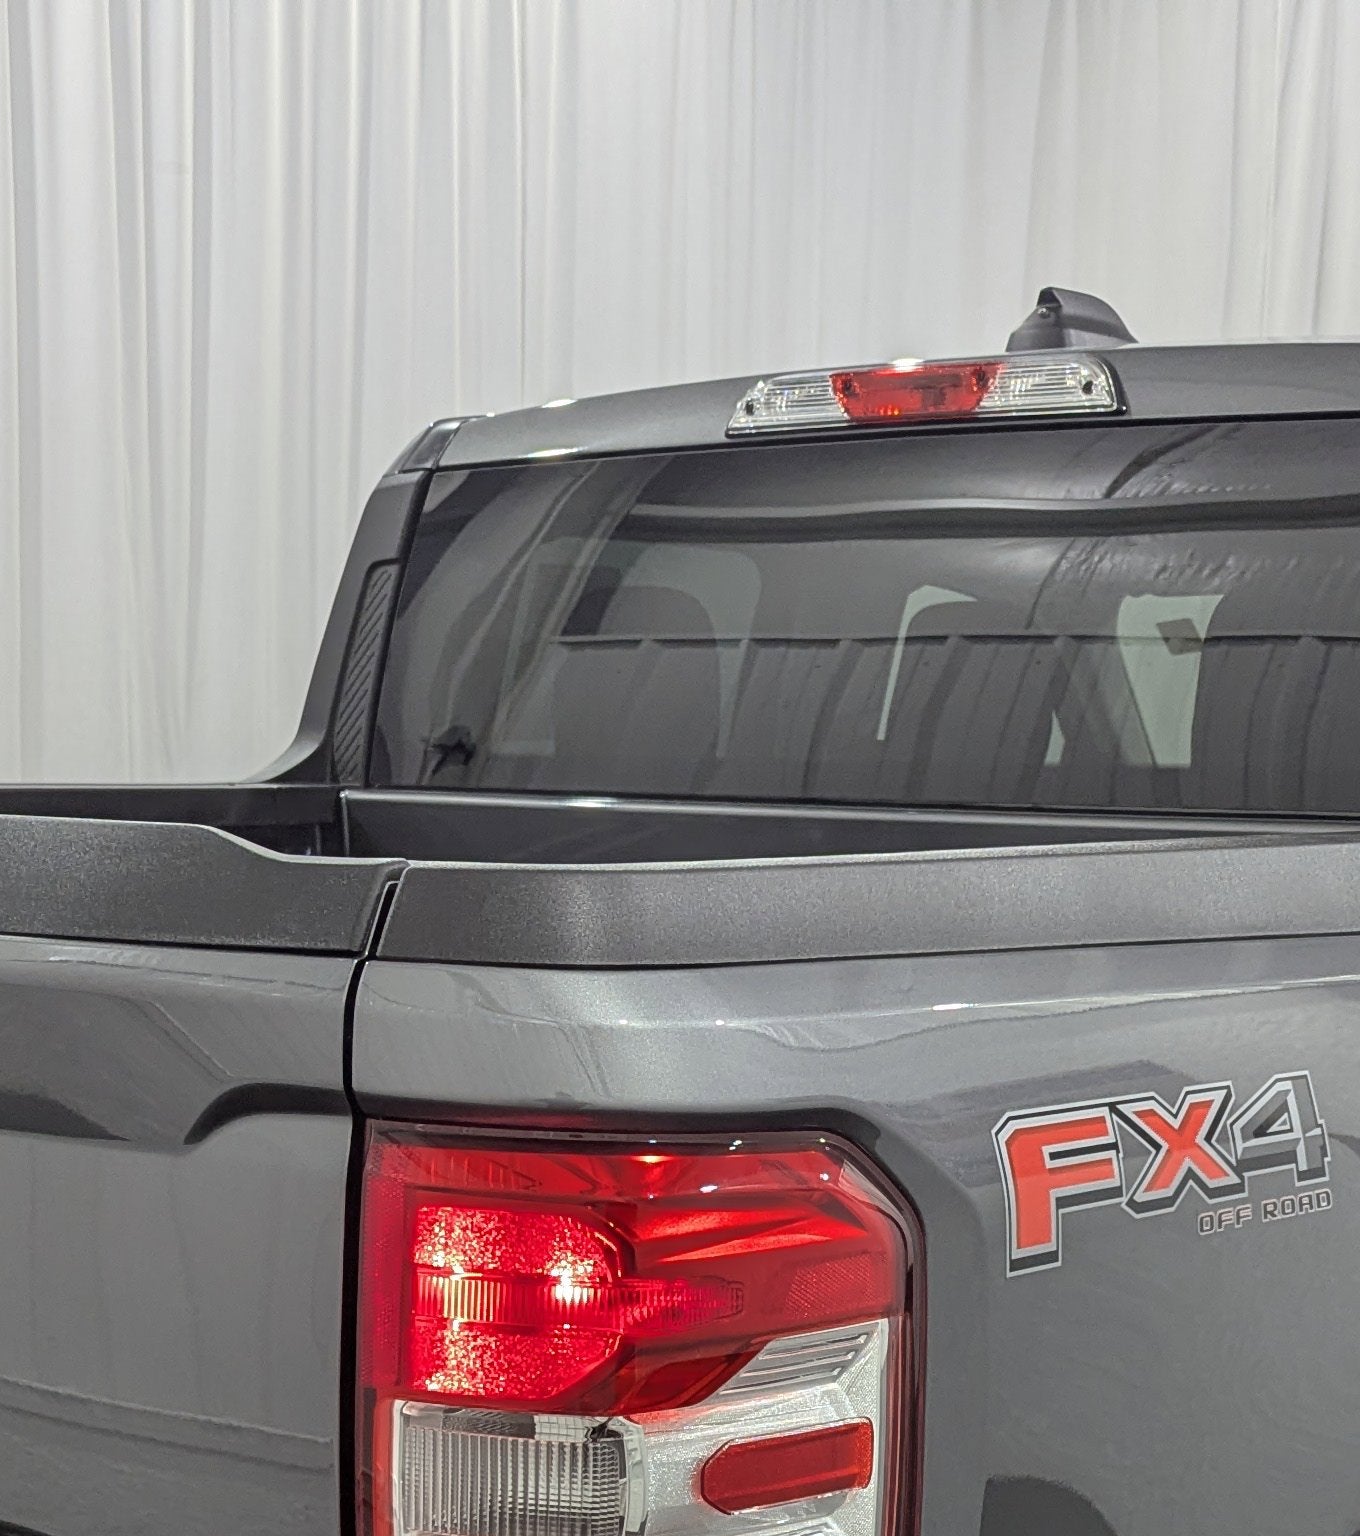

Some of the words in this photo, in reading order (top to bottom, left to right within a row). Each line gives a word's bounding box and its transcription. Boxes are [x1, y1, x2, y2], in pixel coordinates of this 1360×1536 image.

[992, 1070, 1331, 1277] FX4
[1198, 1205, 1253, 1235] OFF
[1262, 1188, 1333, 1222] ROAD
